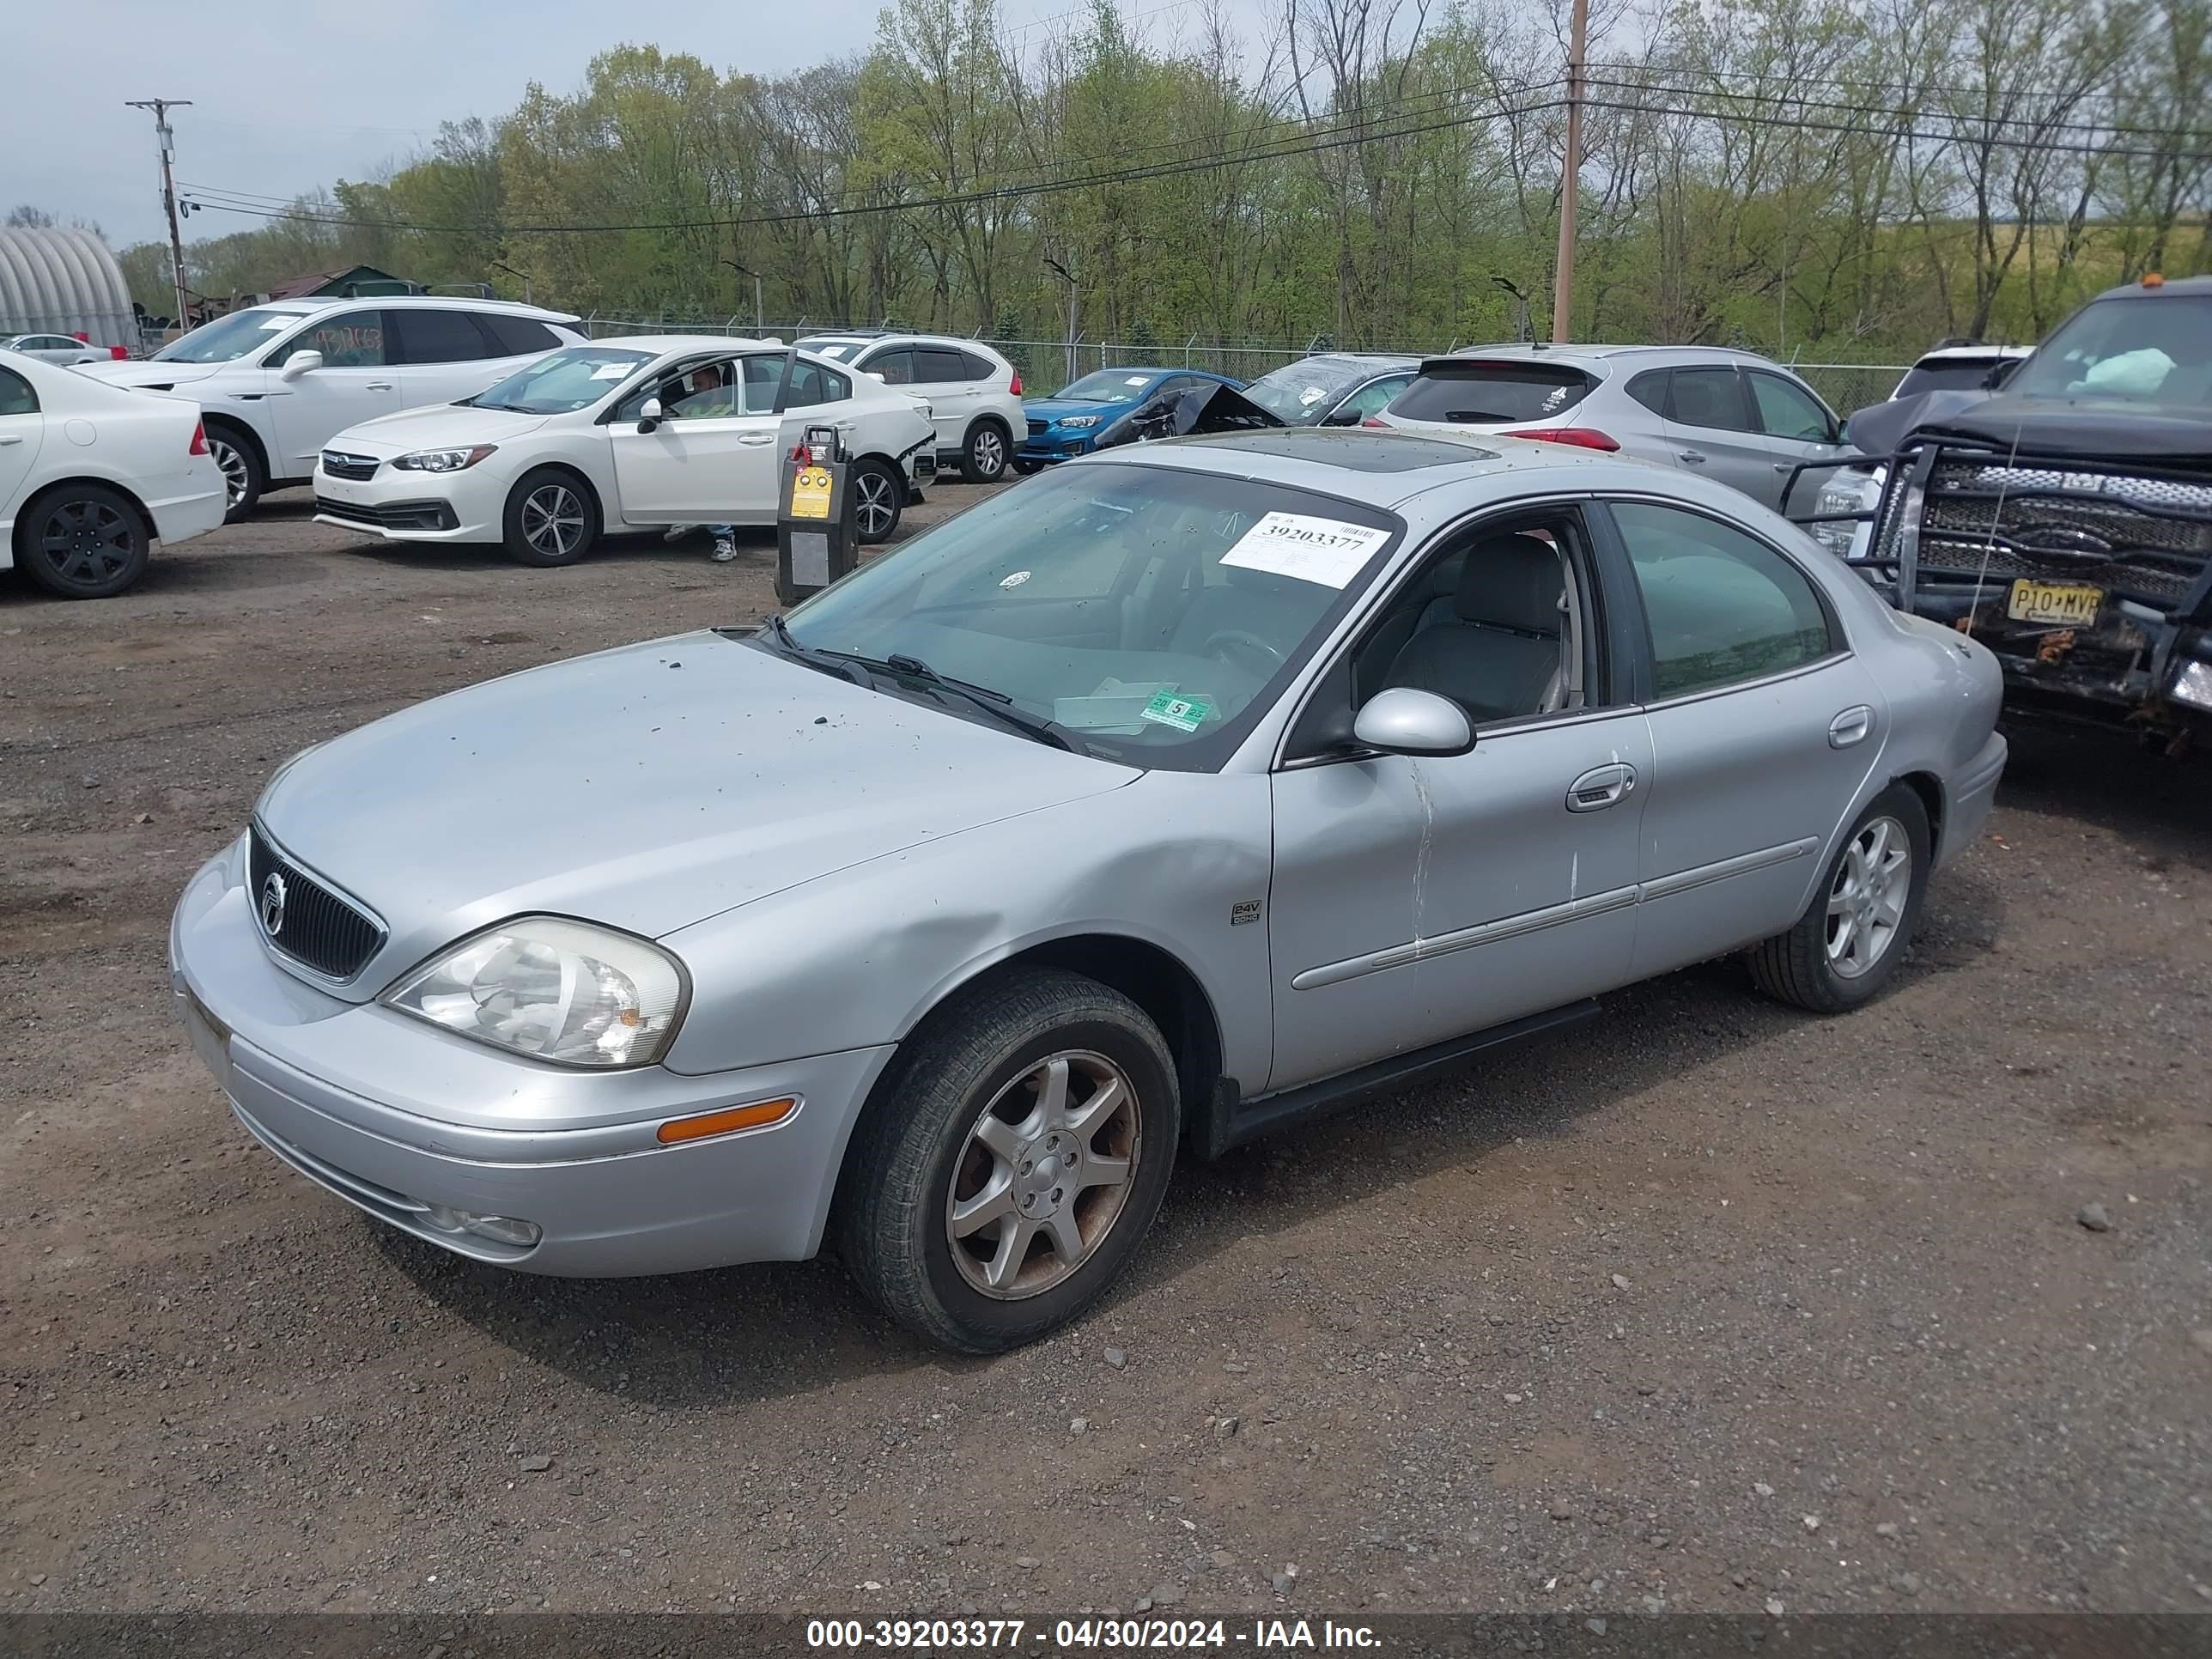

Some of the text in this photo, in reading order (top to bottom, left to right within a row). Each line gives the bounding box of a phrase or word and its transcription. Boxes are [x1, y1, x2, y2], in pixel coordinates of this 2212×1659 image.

[1261, 525, 1365, 550] 39203377
[1153, 697, 1168, 708] 20
[1171, 702, 1185, 714] 5
[1188, 708, 1205, 719] 25
[1234, 902, 1261, 915] 24V
